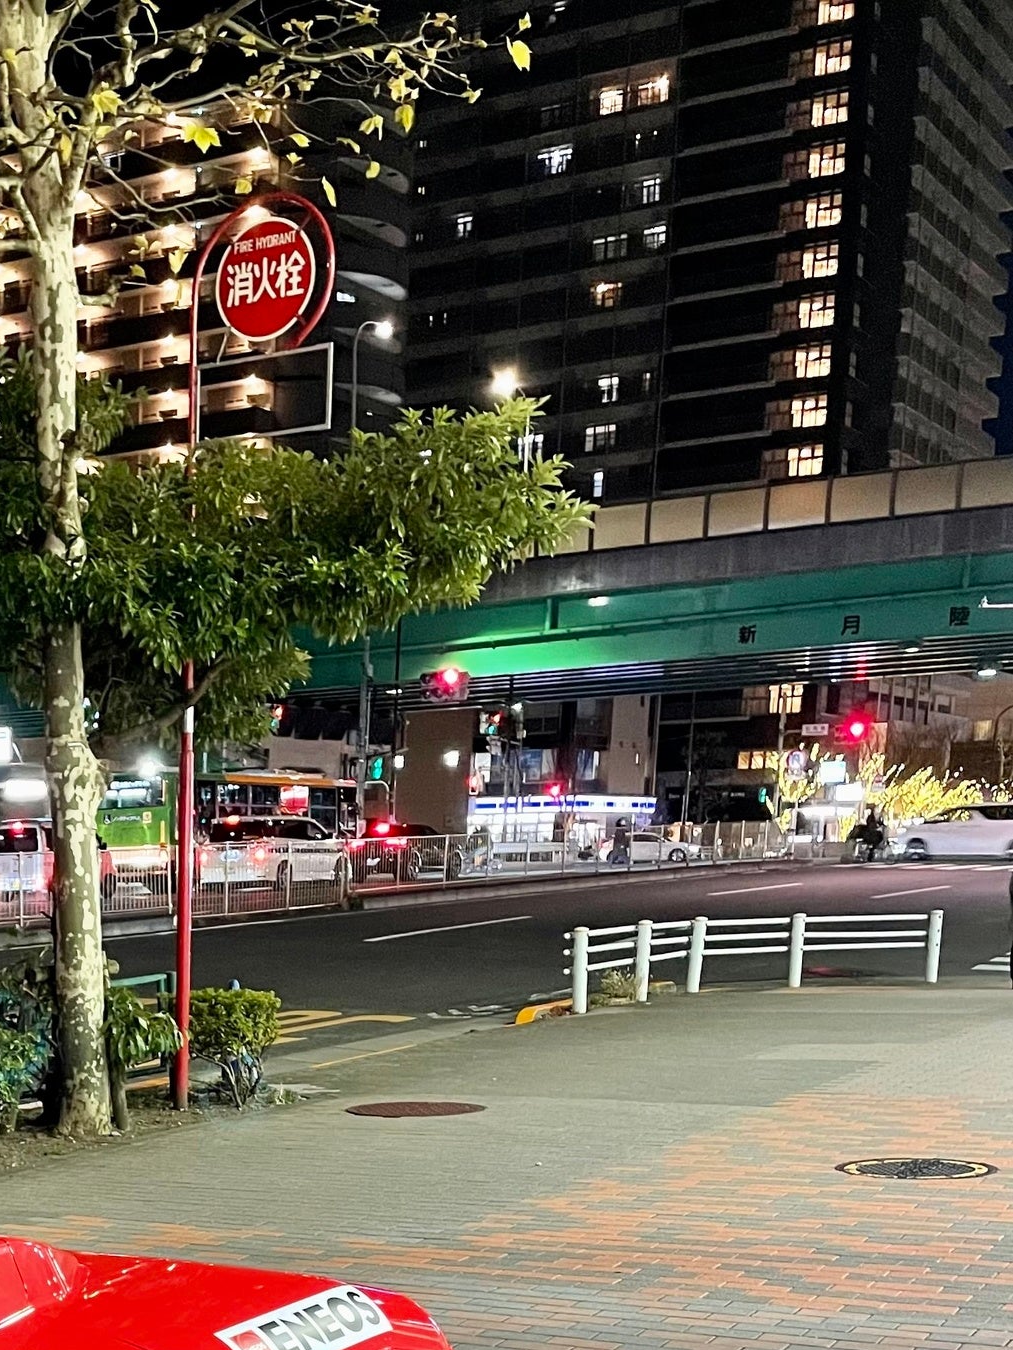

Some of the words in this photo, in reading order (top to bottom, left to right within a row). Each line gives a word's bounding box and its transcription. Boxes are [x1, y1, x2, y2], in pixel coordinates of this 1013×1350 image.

[234, 238, 254, 255] FIRE
[256, 231, 297, 251] HYDRANT
[226, 250, 306, 308] 消火栓
